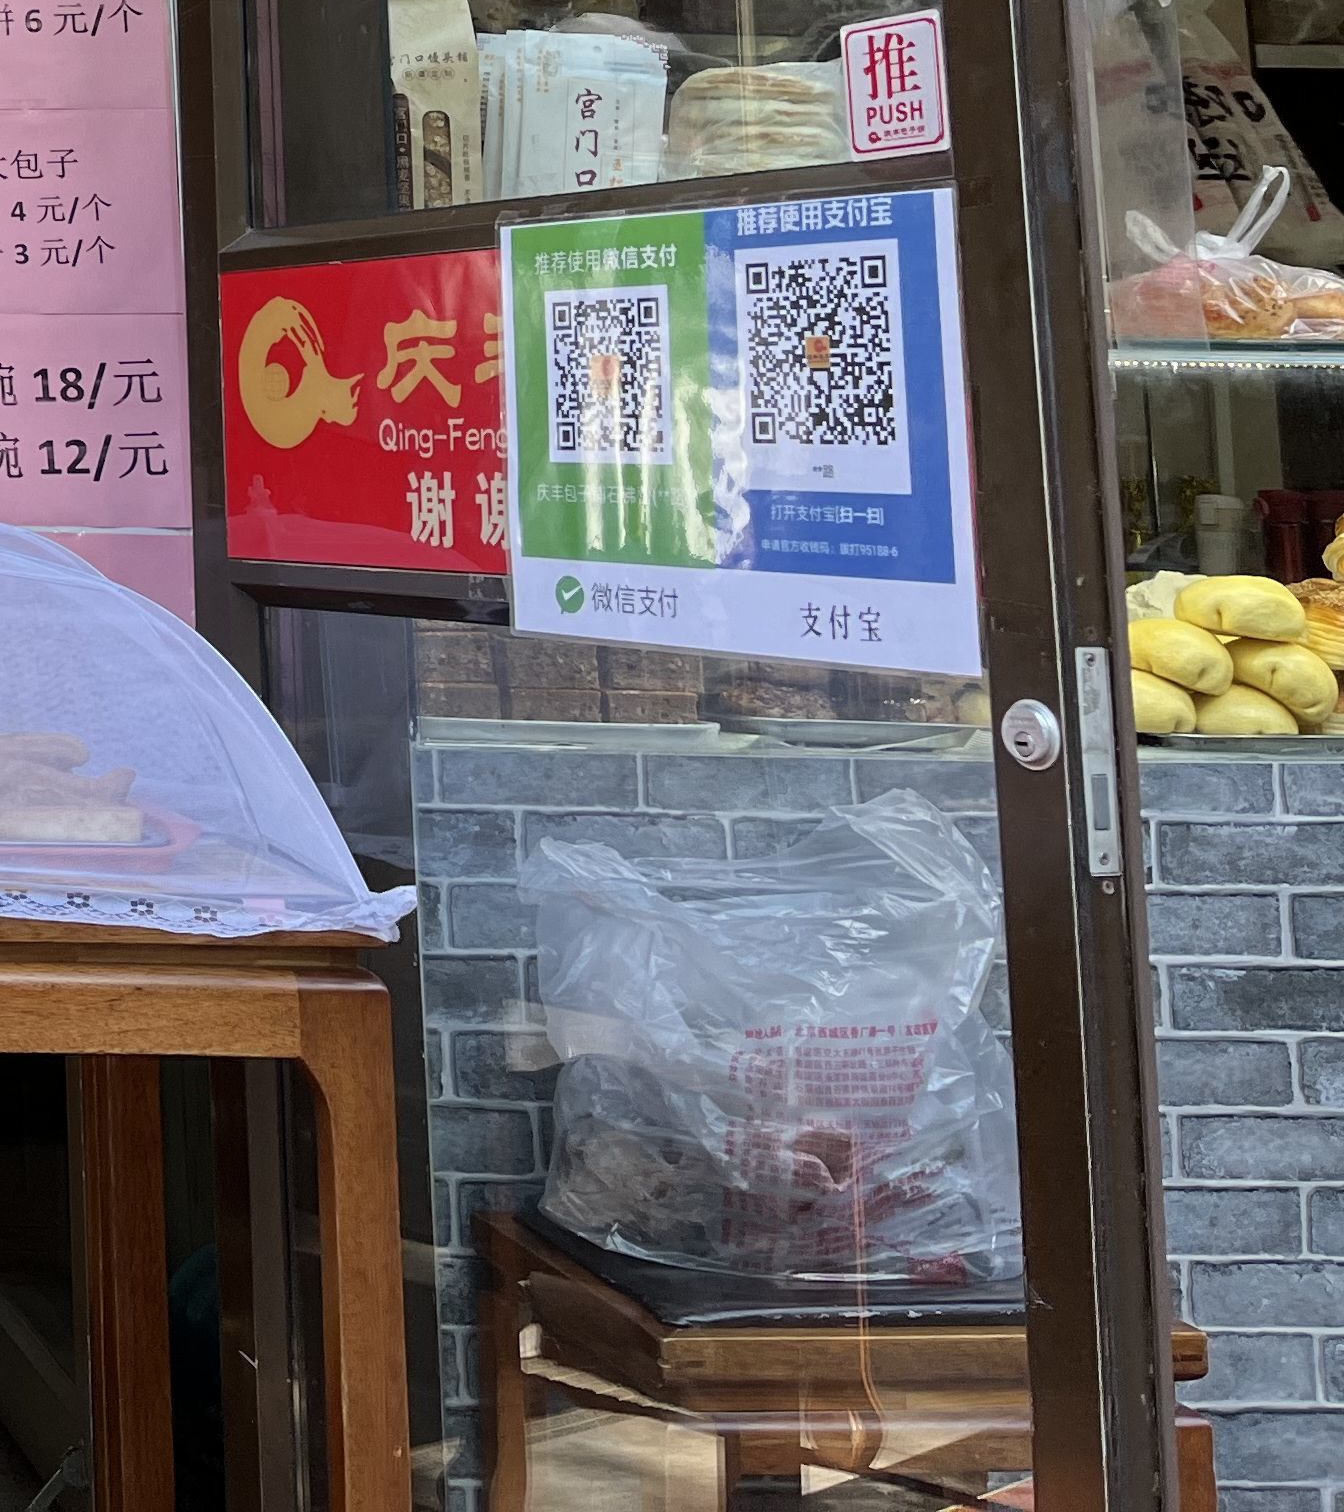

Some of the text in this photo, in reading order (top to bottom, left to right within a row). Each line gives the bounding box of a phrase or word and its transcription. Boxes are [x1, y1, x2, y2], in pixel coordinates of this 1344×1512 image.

[25, 9, 43, 33] 6
[54, 0, 145, 37] 元/个
[861, 33, 922, 100] 推
[866, 100, 923, 127] PUSH
[574, 88, 602, 187] 宫门口
[10, 201, 28, 223] 4
[37, 193, 113, 225] 元/个
[735, 195, 894, 237] 推荐使用支付宝
[14, 245, 30, 265] 3
[40, 235, 117, 267] 元/个
[533, 243, 678, 276] 推荐使用微信支付
[590, 581, 679, 619] 微信支付
[800, 603, 883, 642] 支付宝
